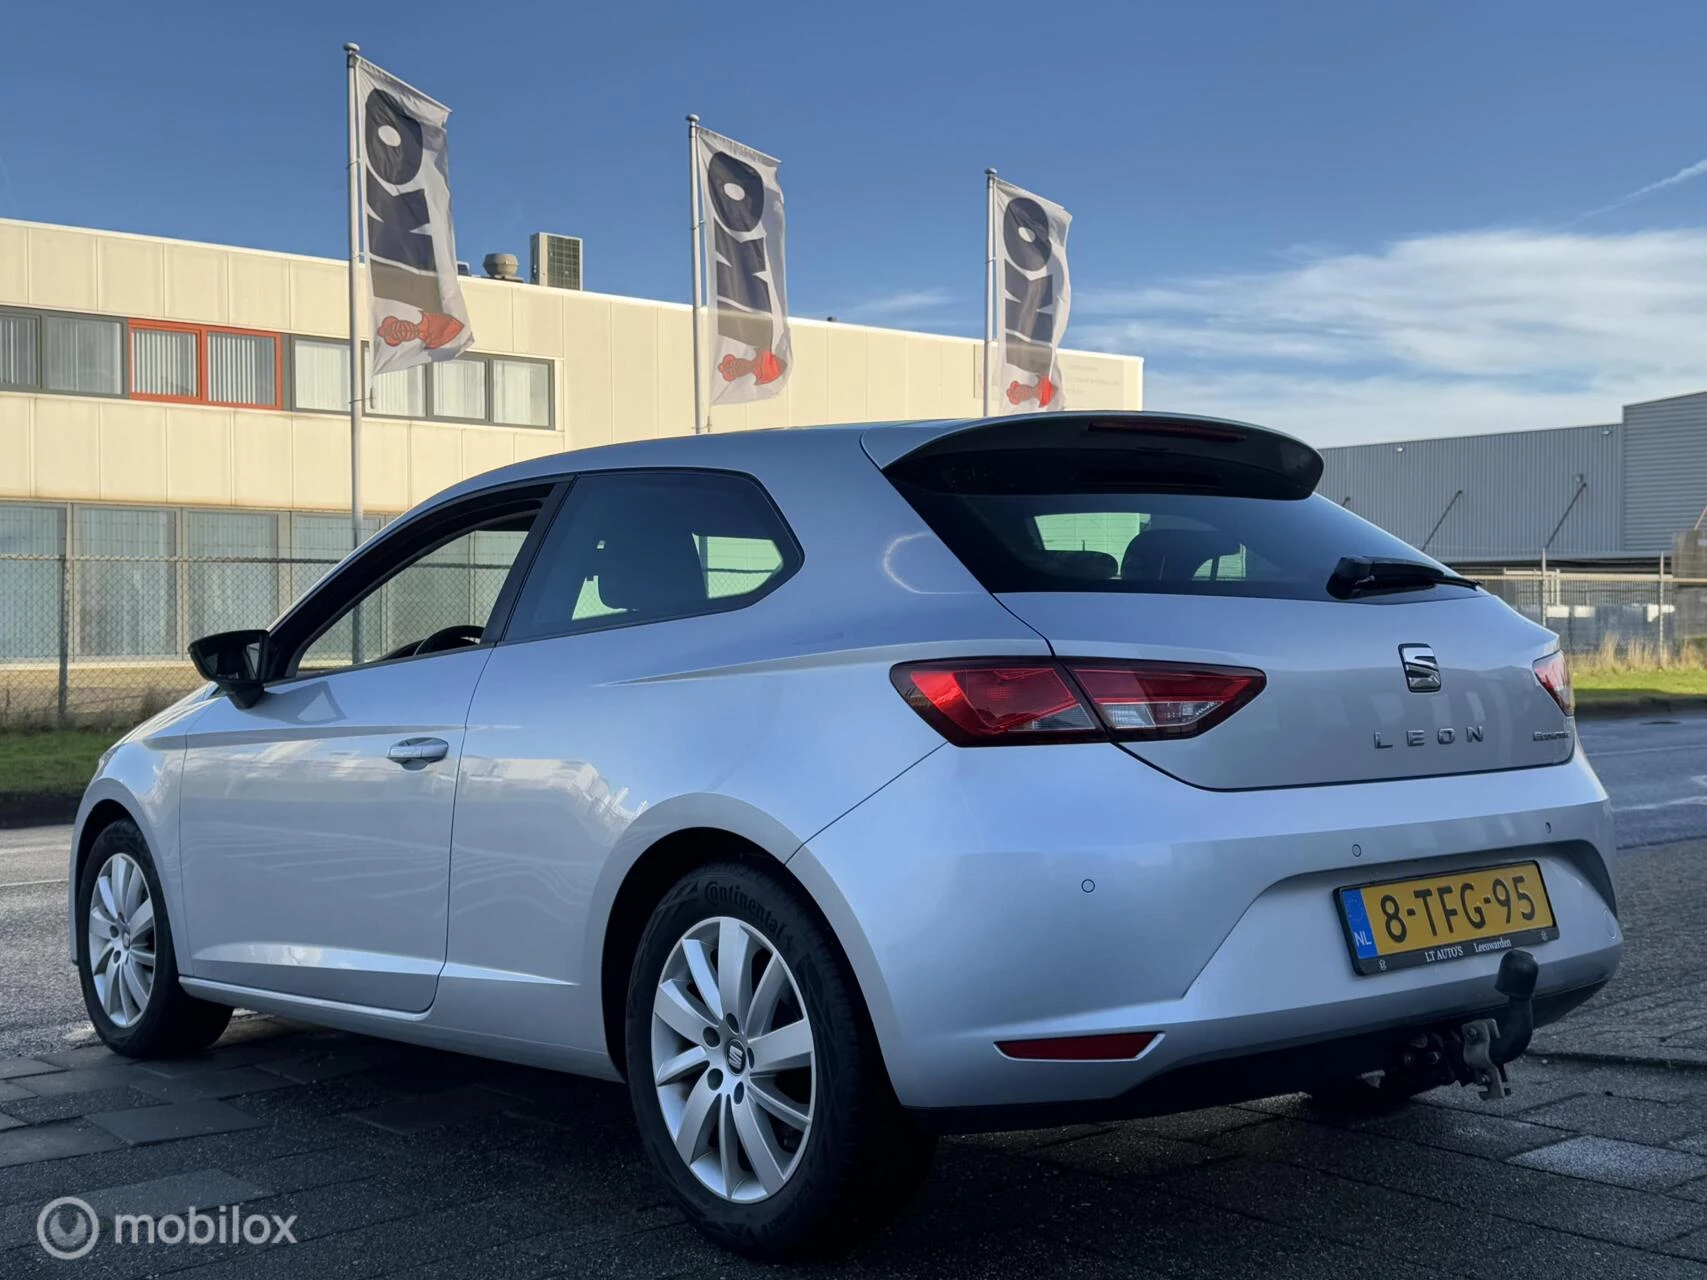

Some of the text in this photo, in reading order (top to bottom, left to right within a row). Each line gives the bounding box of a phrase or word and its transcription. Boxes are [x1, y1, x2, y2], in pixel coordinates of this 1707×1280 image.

[365, 88, 443, 313] IKO
[708, 151, 773, 353] IKO
[1003, 197, 1053, 377] IKO
[1374, 726, 1484, 749] LEON
[705, 880, 788, 941] Continental
[1354, 931, 1373, 946] NL
[1380, 875, 1536, 943] 8-TFG-95
[1425, 937, 1512, 963] LT AUTO'S Leeuwarden
